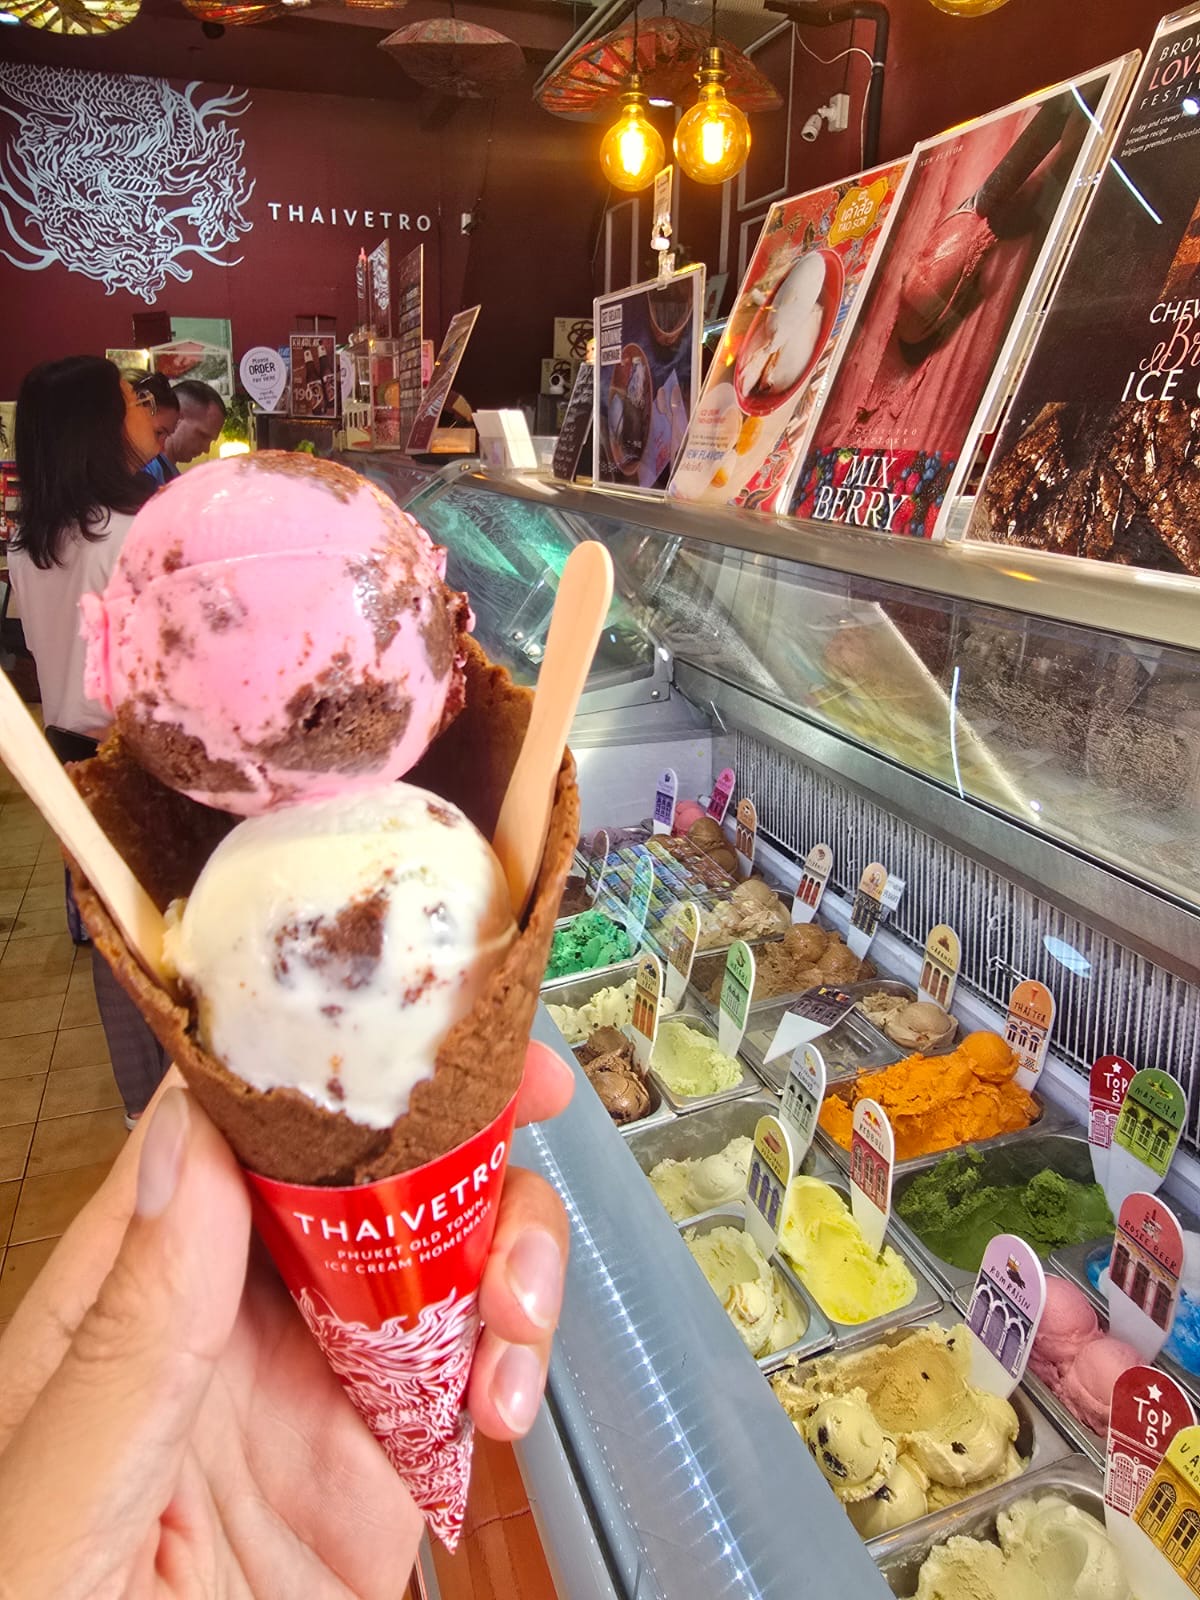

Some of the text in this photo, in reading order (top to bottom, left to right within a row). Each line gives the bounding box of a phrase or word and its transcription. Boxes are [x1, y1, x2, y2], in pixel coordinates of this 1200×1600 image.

[1140, 80, 1200, 110] FESTI
[1148, 118, 1160, 129] and
[1160, 113, 1180, 124] chewy
[1149, 127, 1169, 138] recipe
[1143, 136, 1173, 152] premium
[267, 202, 431, 231] THAIVETRO
[249, 362, 276, 375] ORDER
[1121, 369, 1184, 402] ICE
[842, 455, 898, 489] MIX
[812, 486, 910, 531] BERRY
[1013, 1001, 1047, 1024] THAI TEA
[1111, 1089, 1121, 1102] 5
[293, 1141, 506, 1242] THAIVETRO
[337, 1196, 484, 1261] PHUKET OLD TOWN
[324, 1260, 349, 1273] ICE
[355, 1257, 414, 1275] CREAM
[1153, 1245, 1177, 1271] BEER
[1006, 1283, 1031, 1310] RAISIN
[1145, 1425, 1158, 1448] 5
